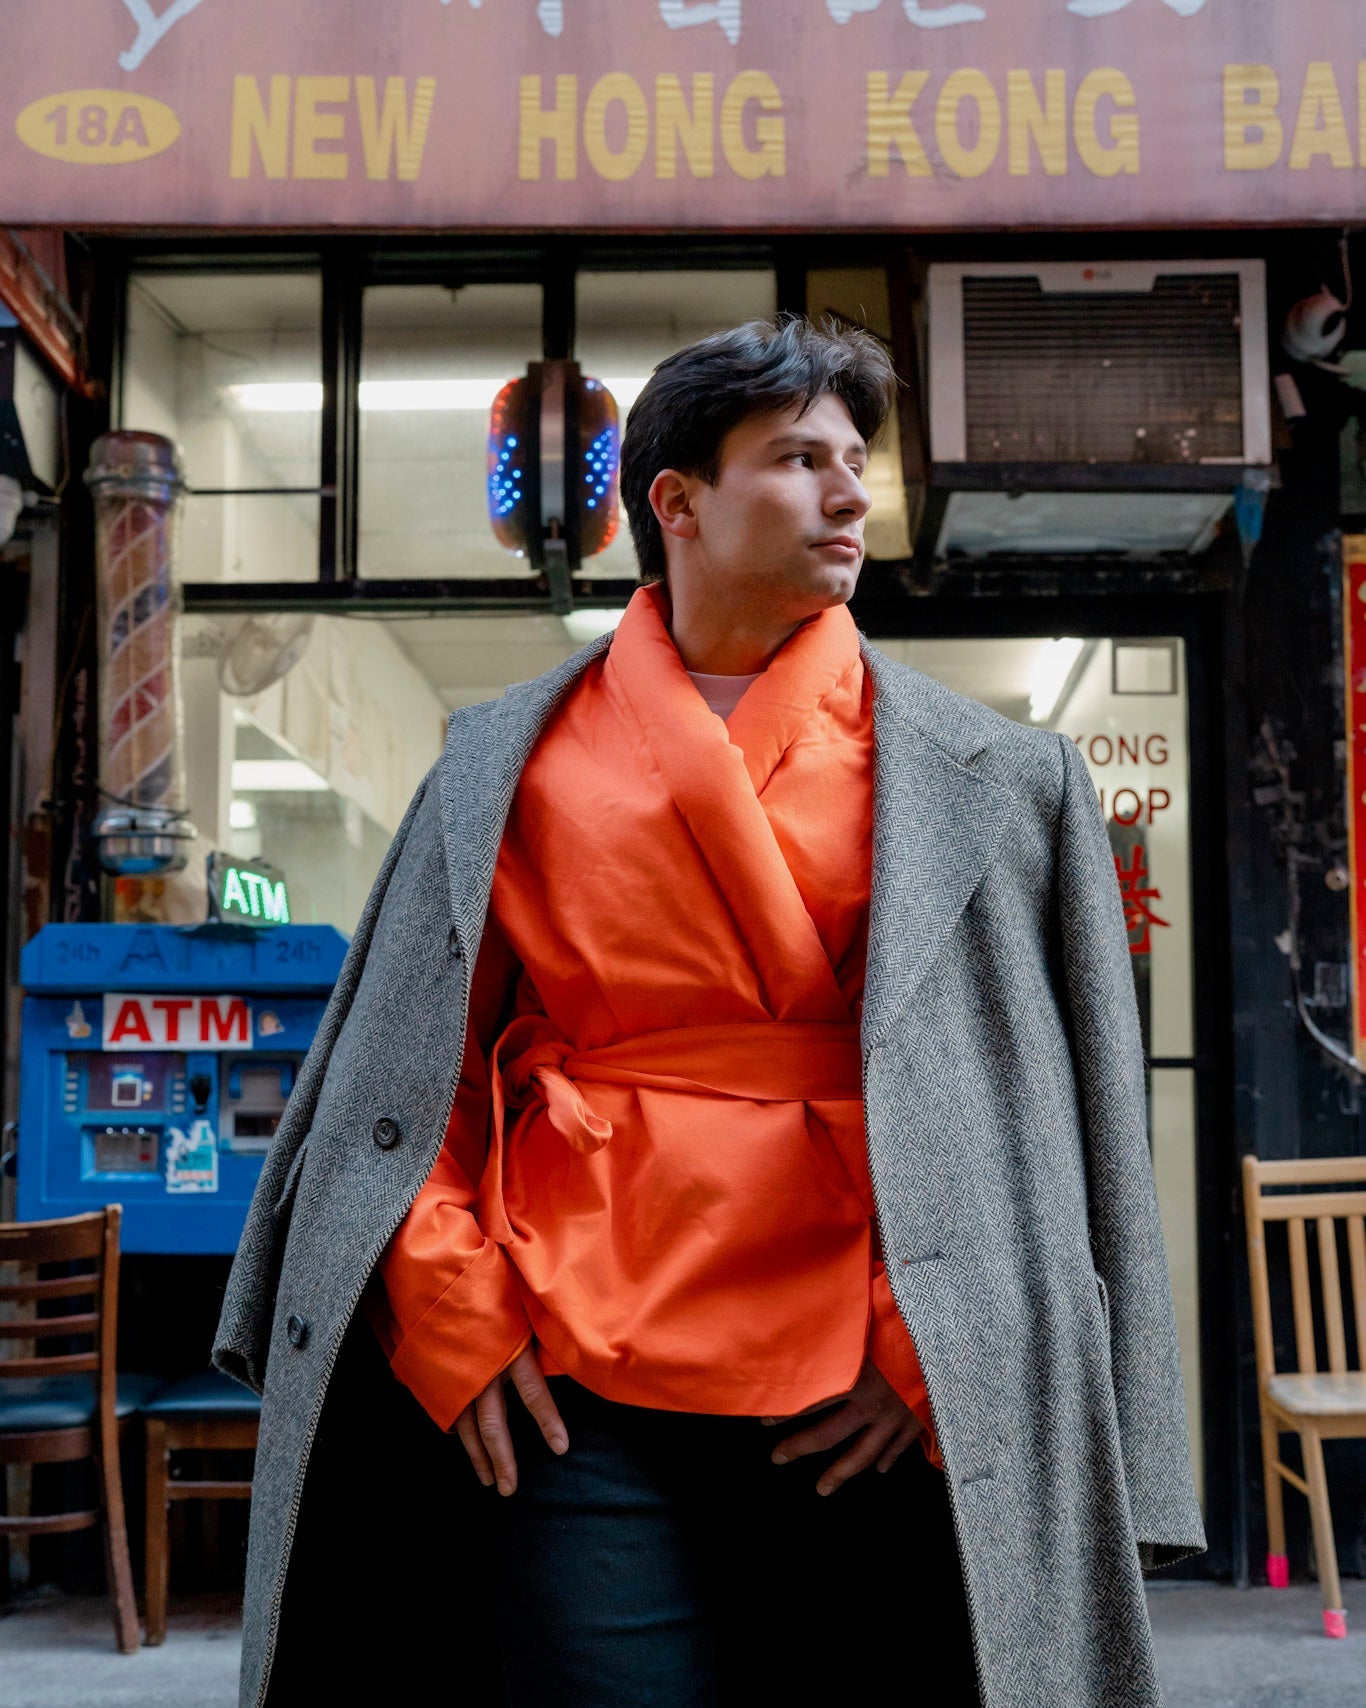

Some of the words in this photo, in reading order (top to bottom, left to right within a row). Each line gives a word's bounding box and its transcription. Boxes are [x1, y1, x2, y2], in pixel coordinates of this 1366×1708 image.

[44, 105, 150, 147] 18A
[229, 74, 437, 181] NEW
[518, 70, 786, 181] HONG
[866, 67, 1140, 178] KONG
[1223, 60, 1366, 171] BA
[1074, 734, 1168, 766] ONG
[223, 867, 290, 924] ATM
[56, 941, 100, 963] 24h
[276, 939, 321, 963] 24h
[109, 998, 249, 1042] ATM
